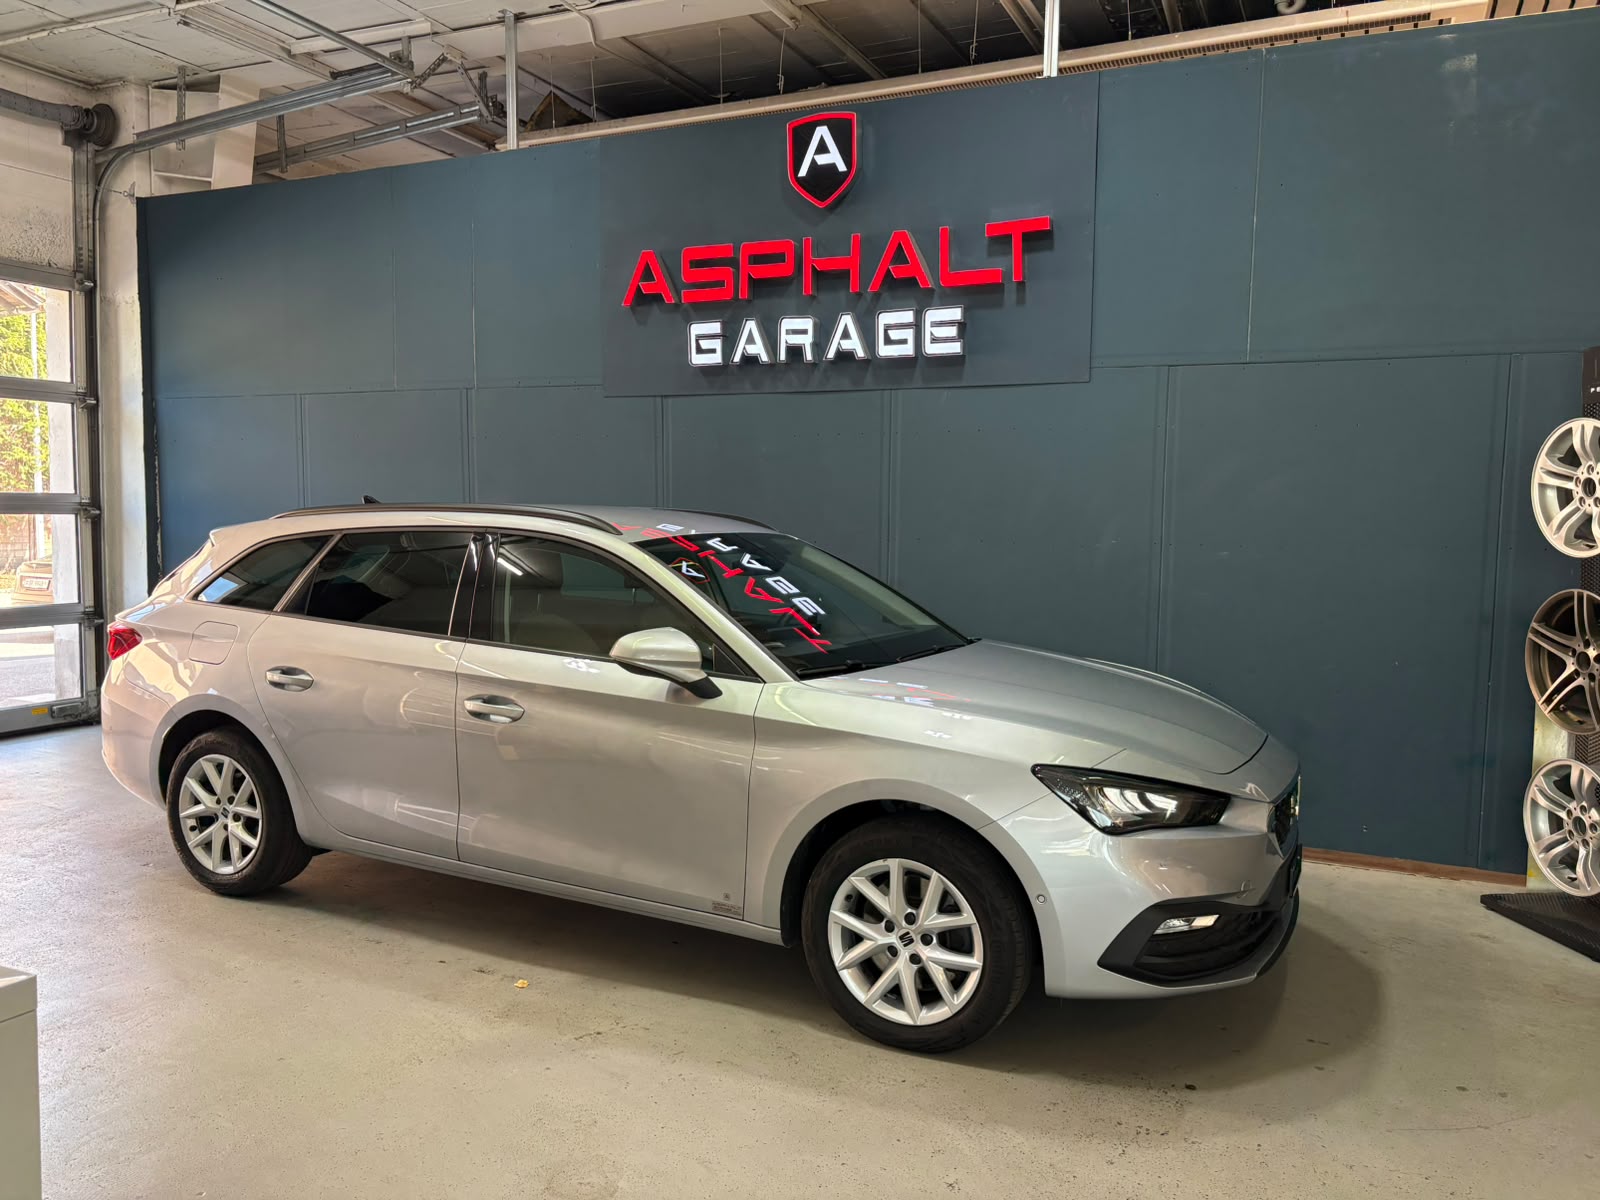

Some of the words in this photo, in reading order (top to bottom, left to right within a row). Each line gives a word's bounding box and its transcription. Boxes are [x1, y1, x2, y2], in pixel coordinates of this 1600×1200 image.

[797, 125, 848, 177] A
[622, 216, 1051, 307] ASPHALT
[687, 305, 964, 367] GARAGE
